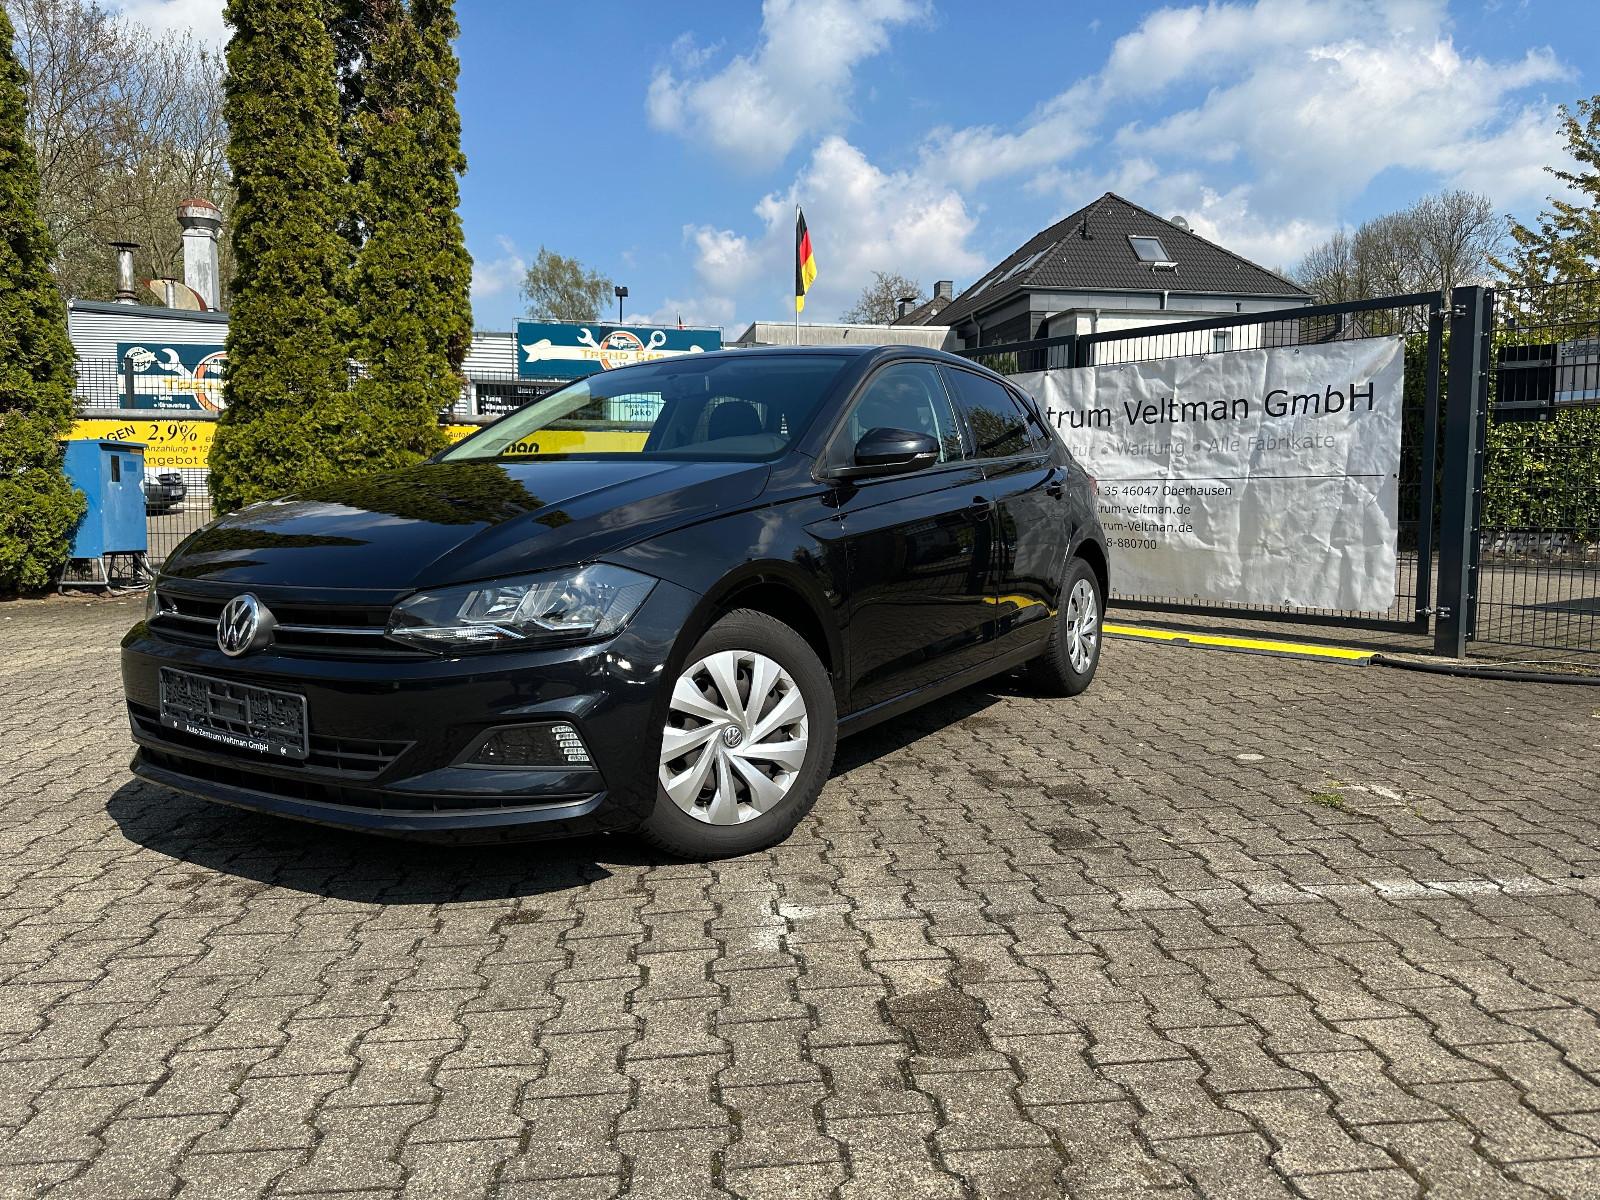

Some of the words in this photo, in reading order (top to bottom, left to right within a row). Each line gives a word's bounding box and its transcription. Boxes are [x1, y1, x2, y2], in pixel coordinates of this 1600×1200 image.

[1046, 406, 1111, 428] trum
[1123, 397, 1249, 426] Veltman
[1264, 382, 1374, 417] GmbH
[631, 408, 652, 417] Jako
[100, 424, 136, 441] GEN
[147, 424, 197, 443] 2,9%
[1117, 441, 1185, 457] Wartung
[1209, 437, 1240, 452] Alle
[1247, 432, 1335, 450] Fabrikate
[1104, 486, 1118, 496] 35
[1121, 486, 1158, 496] 46047
[1162, 485, 1232, 496] Oberhausen
[1101, 522, 1193, 533] rum-Veltman.de
[1106, 538, 1157, 549] 8-880700
[248, 740, 269, 751] GmbH
